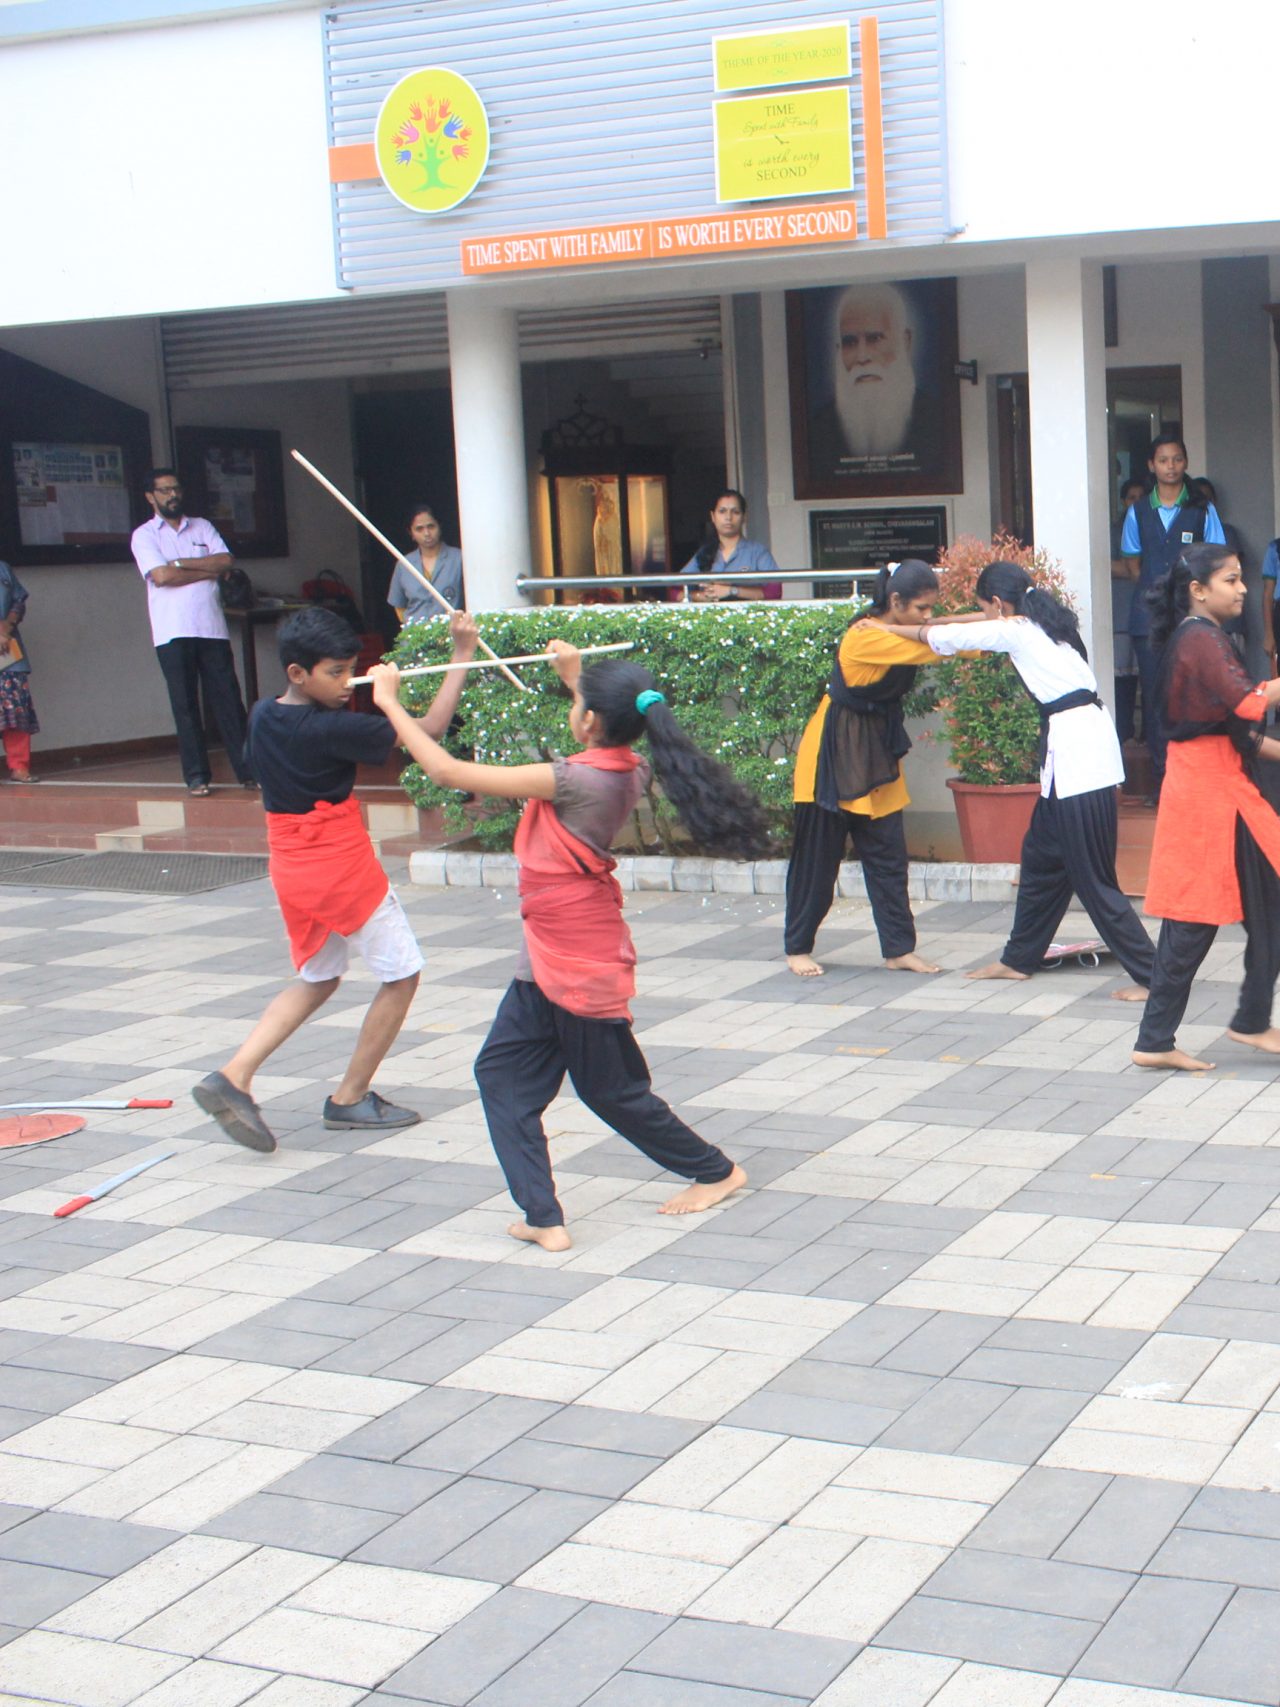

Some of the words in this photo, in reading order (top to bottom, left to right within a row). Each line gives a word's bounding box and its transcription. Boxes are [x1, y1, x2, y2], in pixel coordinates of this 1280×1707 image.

[723, 56, 753, 69] THEME
[757, 55, 769, 65] OF
[772, 53, 788, 64] THE
[764, 103, 796, 117] TIME
[744, 157, 752, 168] is
[758, 149, 791, 166] worth
[793, 152, 820, 169] every
[756, 166, 807, 182] SECOND
[466, 242, 502, 267] TIME
[503, 237, 548, 263] SPENT
[549, 231, 587, 258] WITH
[591, 227, 645, 255] FAMILY
[657, 226, 673, 249] IS
[674, 220, 730, 247] WORTH
[733, 215, 784, 243] EVERY
[787, 209, 852, 238] SECOND
